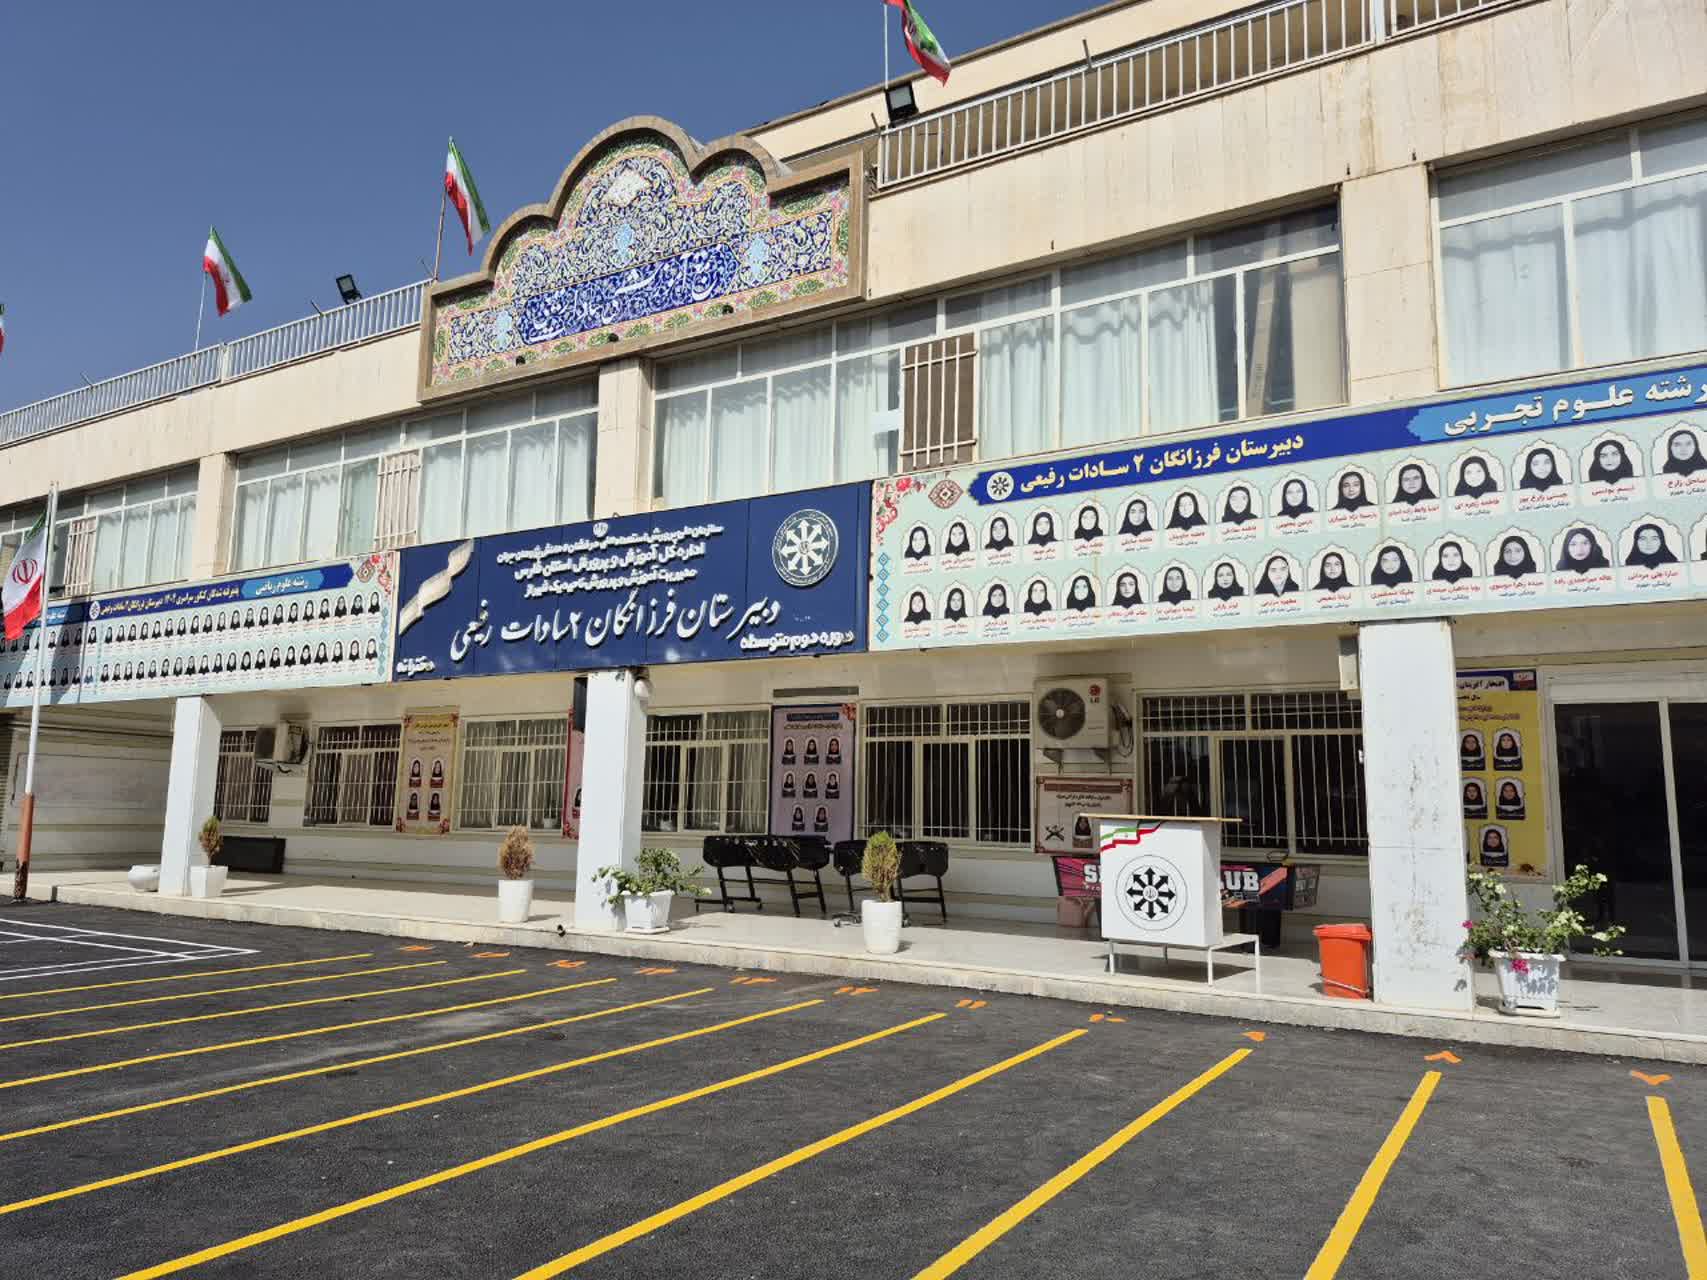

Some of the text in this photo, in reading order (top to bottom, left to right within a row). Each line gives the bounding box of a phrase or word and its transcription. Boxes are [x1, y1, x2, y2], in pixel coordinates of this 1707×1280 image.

[1444, 375, 1707, 435] رشته علوم تجربی
[1020, 435, 1304, 492] دبیرستان فرزانگان ۲ سادات رفیعی
[620, 544, 659, 567] آموزش
[659, 545, 677, 563] کل
[676, 542, 705, 560] اداره
[514, 559, 543, 580] فارس
[543, 558, 572, 577] استان
[573, 555, 611, 574] پرورش
[623, 564, 659, 586] آموزش
[658, 568, 698, 582] مدیریت
[524, 580, 549, 598] شیراز
[584, 573, 617, 590] پرورش
[450, 587, 781, 661] دبیرستان فرزانگان ۲ سادات رفیعی
[740, 630, 854, 651] دوره دوم متوسطه
[397, 656, 436, 677] دخترانه
